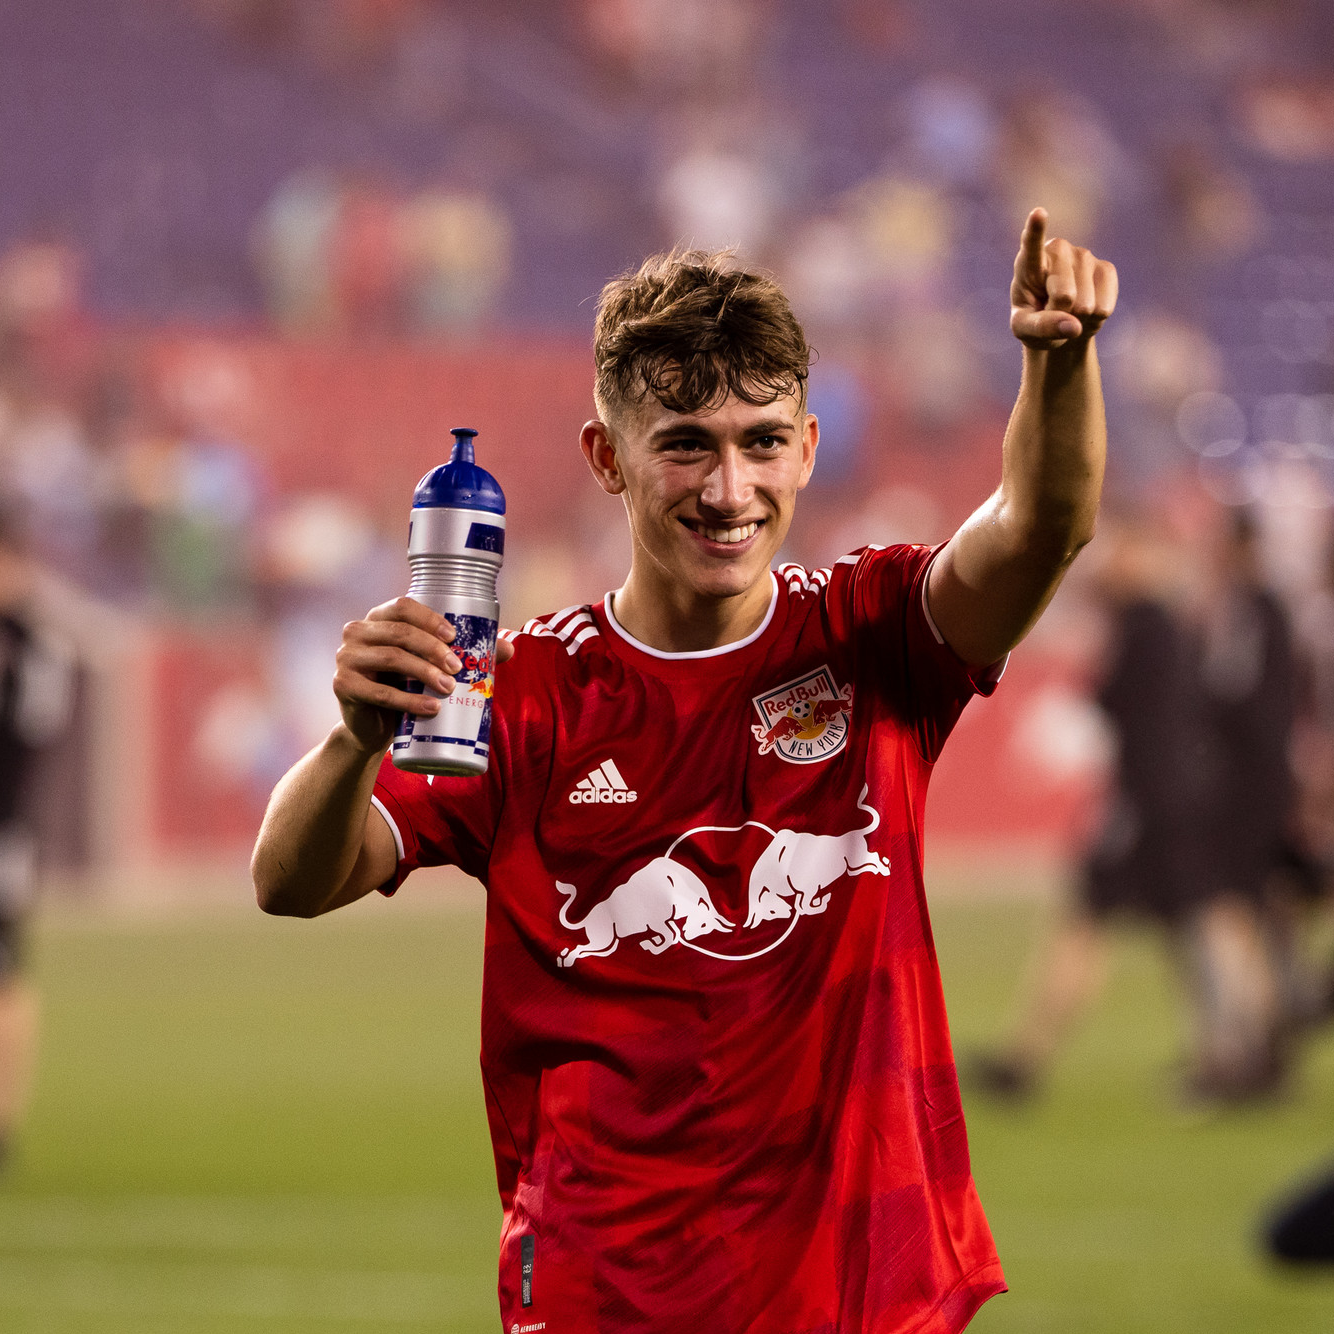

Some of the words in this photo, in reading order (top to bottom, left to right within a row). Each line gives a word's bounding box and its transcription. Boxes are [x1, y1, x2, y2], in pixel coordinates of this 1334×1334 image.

[763, 690, 796, 716] Red
[795, 676, 829, 701] Bull
[788, 740, 813, 756] NEW
[817, 723, 844, 751] YORK
[568, 786, 638, 805] adidas
